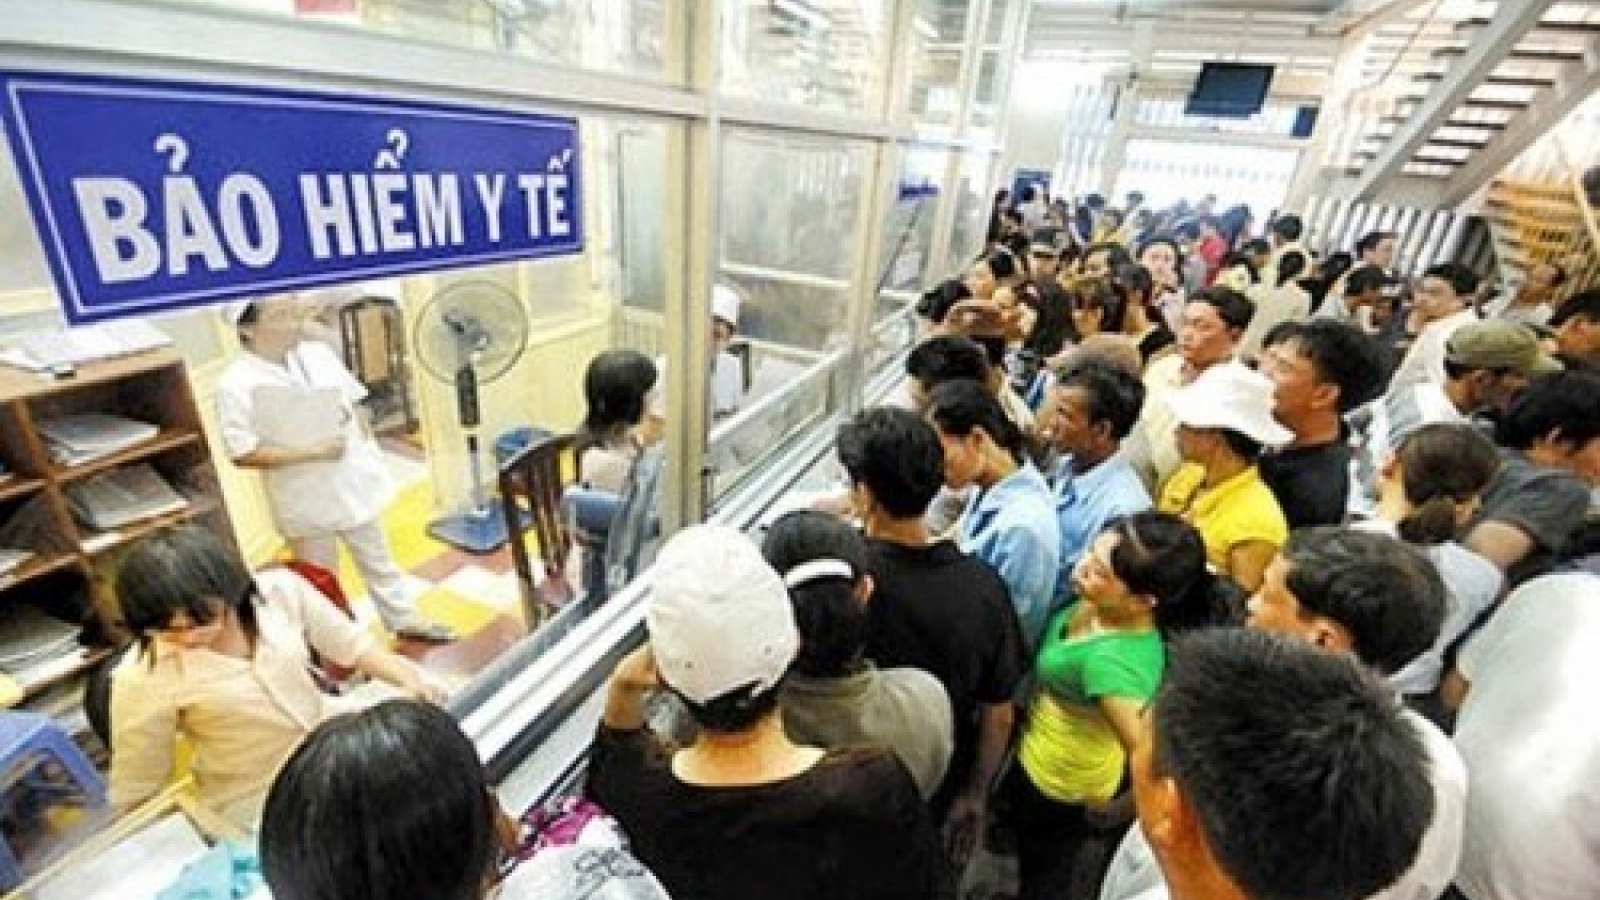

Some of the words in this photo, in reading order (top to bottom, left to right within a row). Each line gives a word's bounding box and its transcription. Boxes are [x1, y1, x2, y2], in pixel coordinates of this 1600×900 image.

[72, 133, 279, 284] BẢO
[299, 129, 465, 259] HIỂM
[473, 173, 506, 243] Y
[518, 148, 573, 237] TẾ
